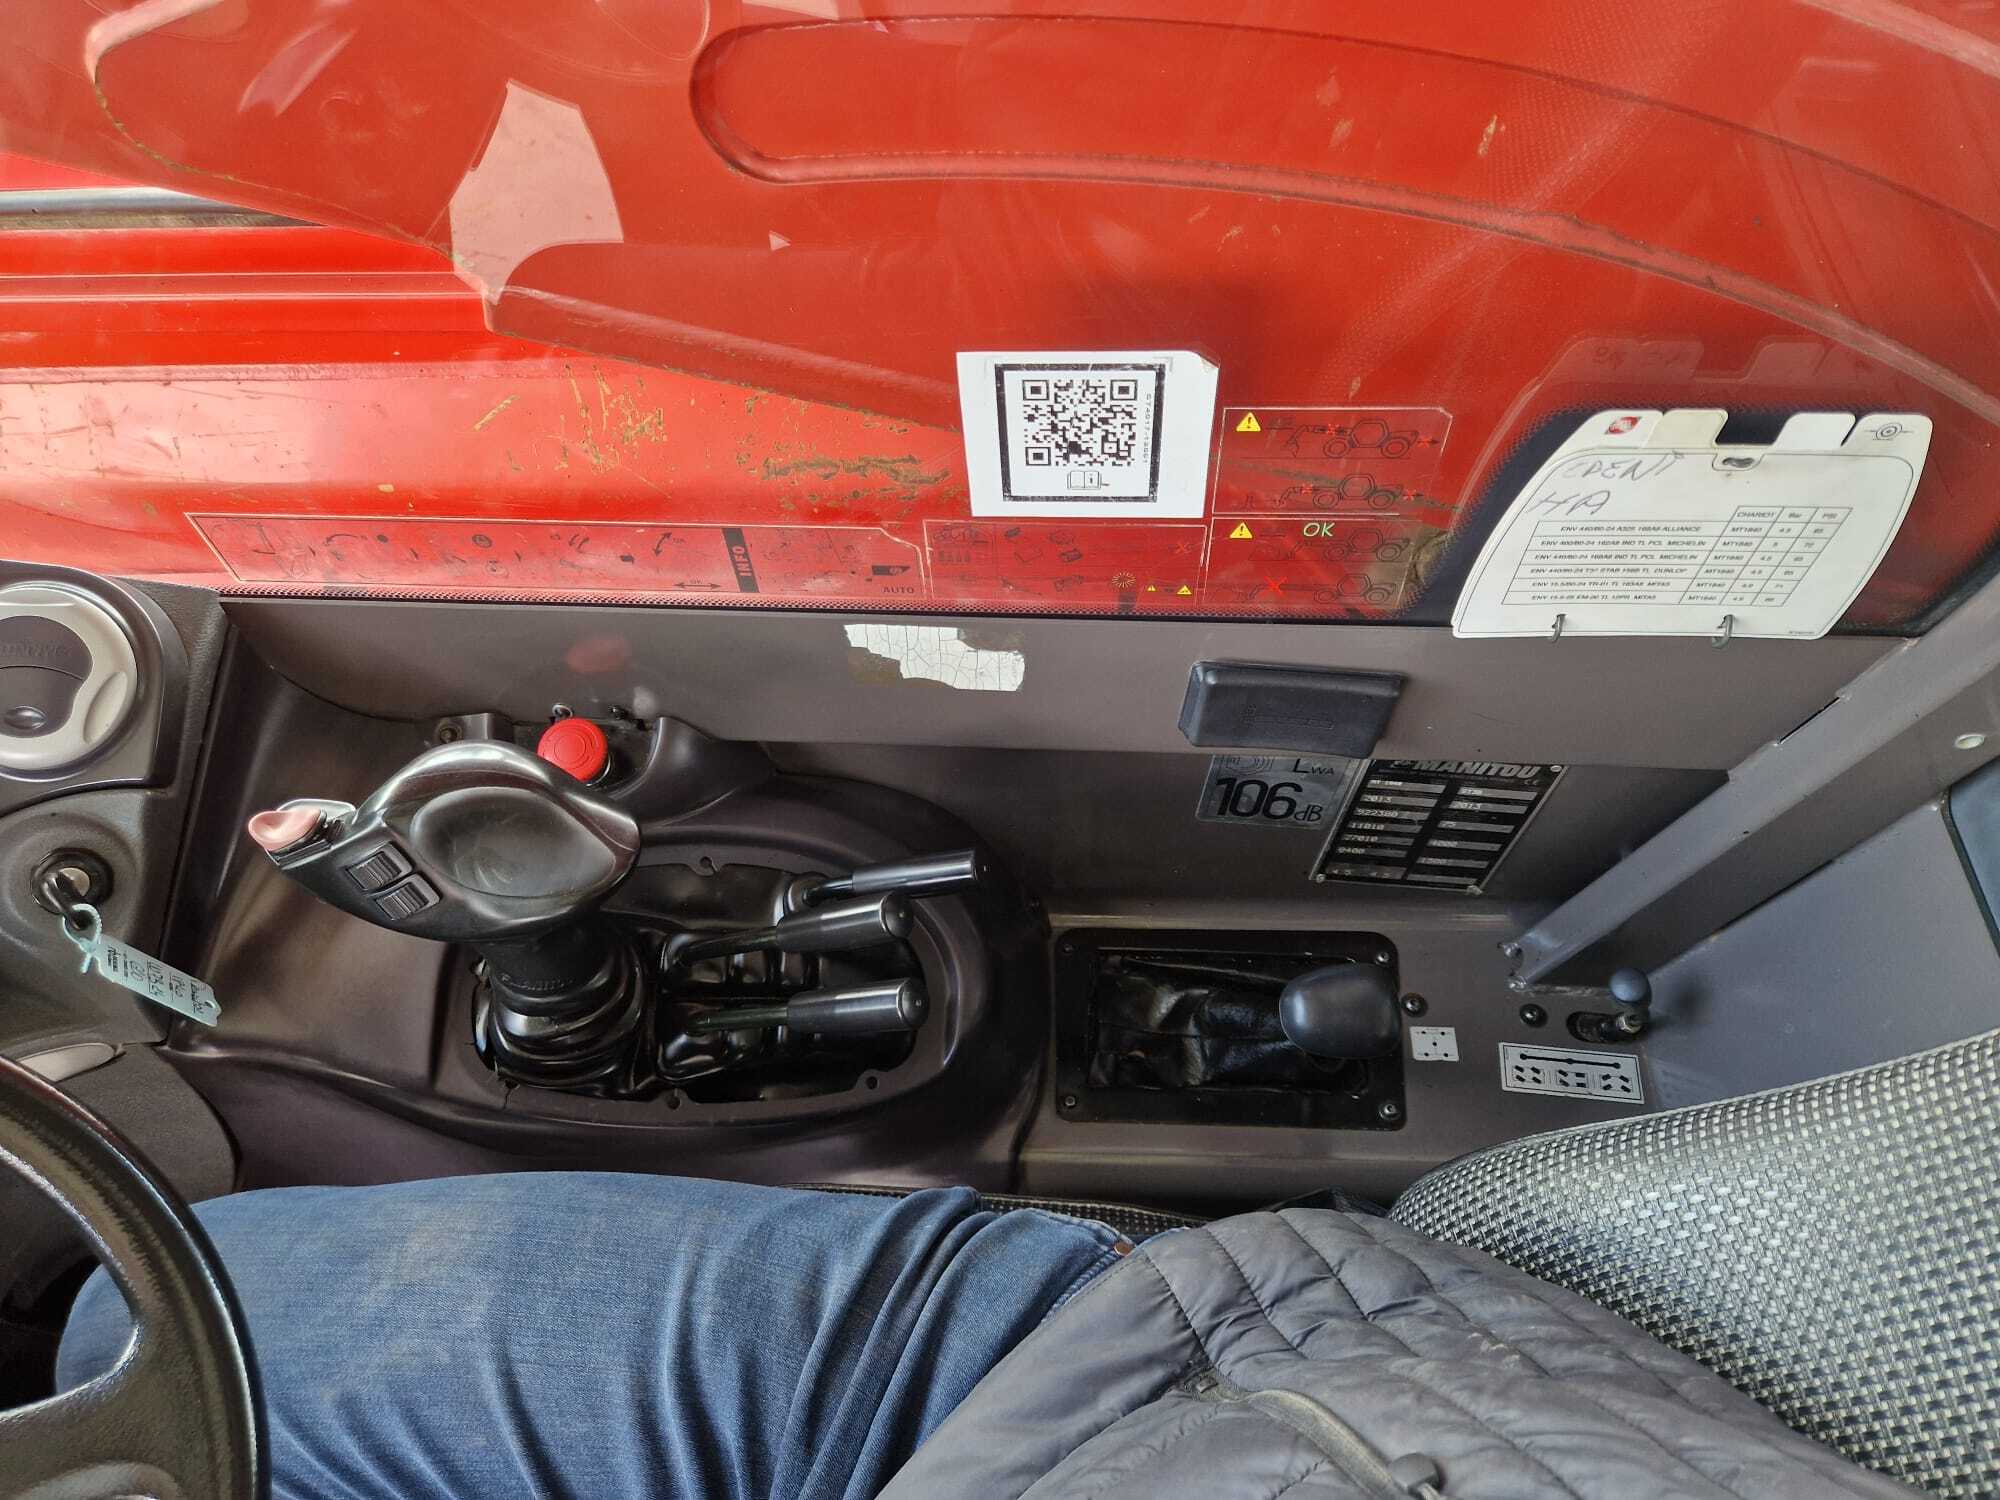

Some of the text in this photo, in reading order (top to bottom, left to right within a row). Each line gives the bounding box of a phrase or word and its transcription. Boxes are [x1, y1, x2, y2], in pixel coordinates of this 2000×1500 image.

[1303, 522, 1336, 537] OK
[732, 545, 752, 577] INFO
[882, 586, 914, 594] AUTO
[1412, 760, 1542, 779] MANITOU
[1215, 777, 1303, 819] 106
[1293, 804, 1323, 822] dB
